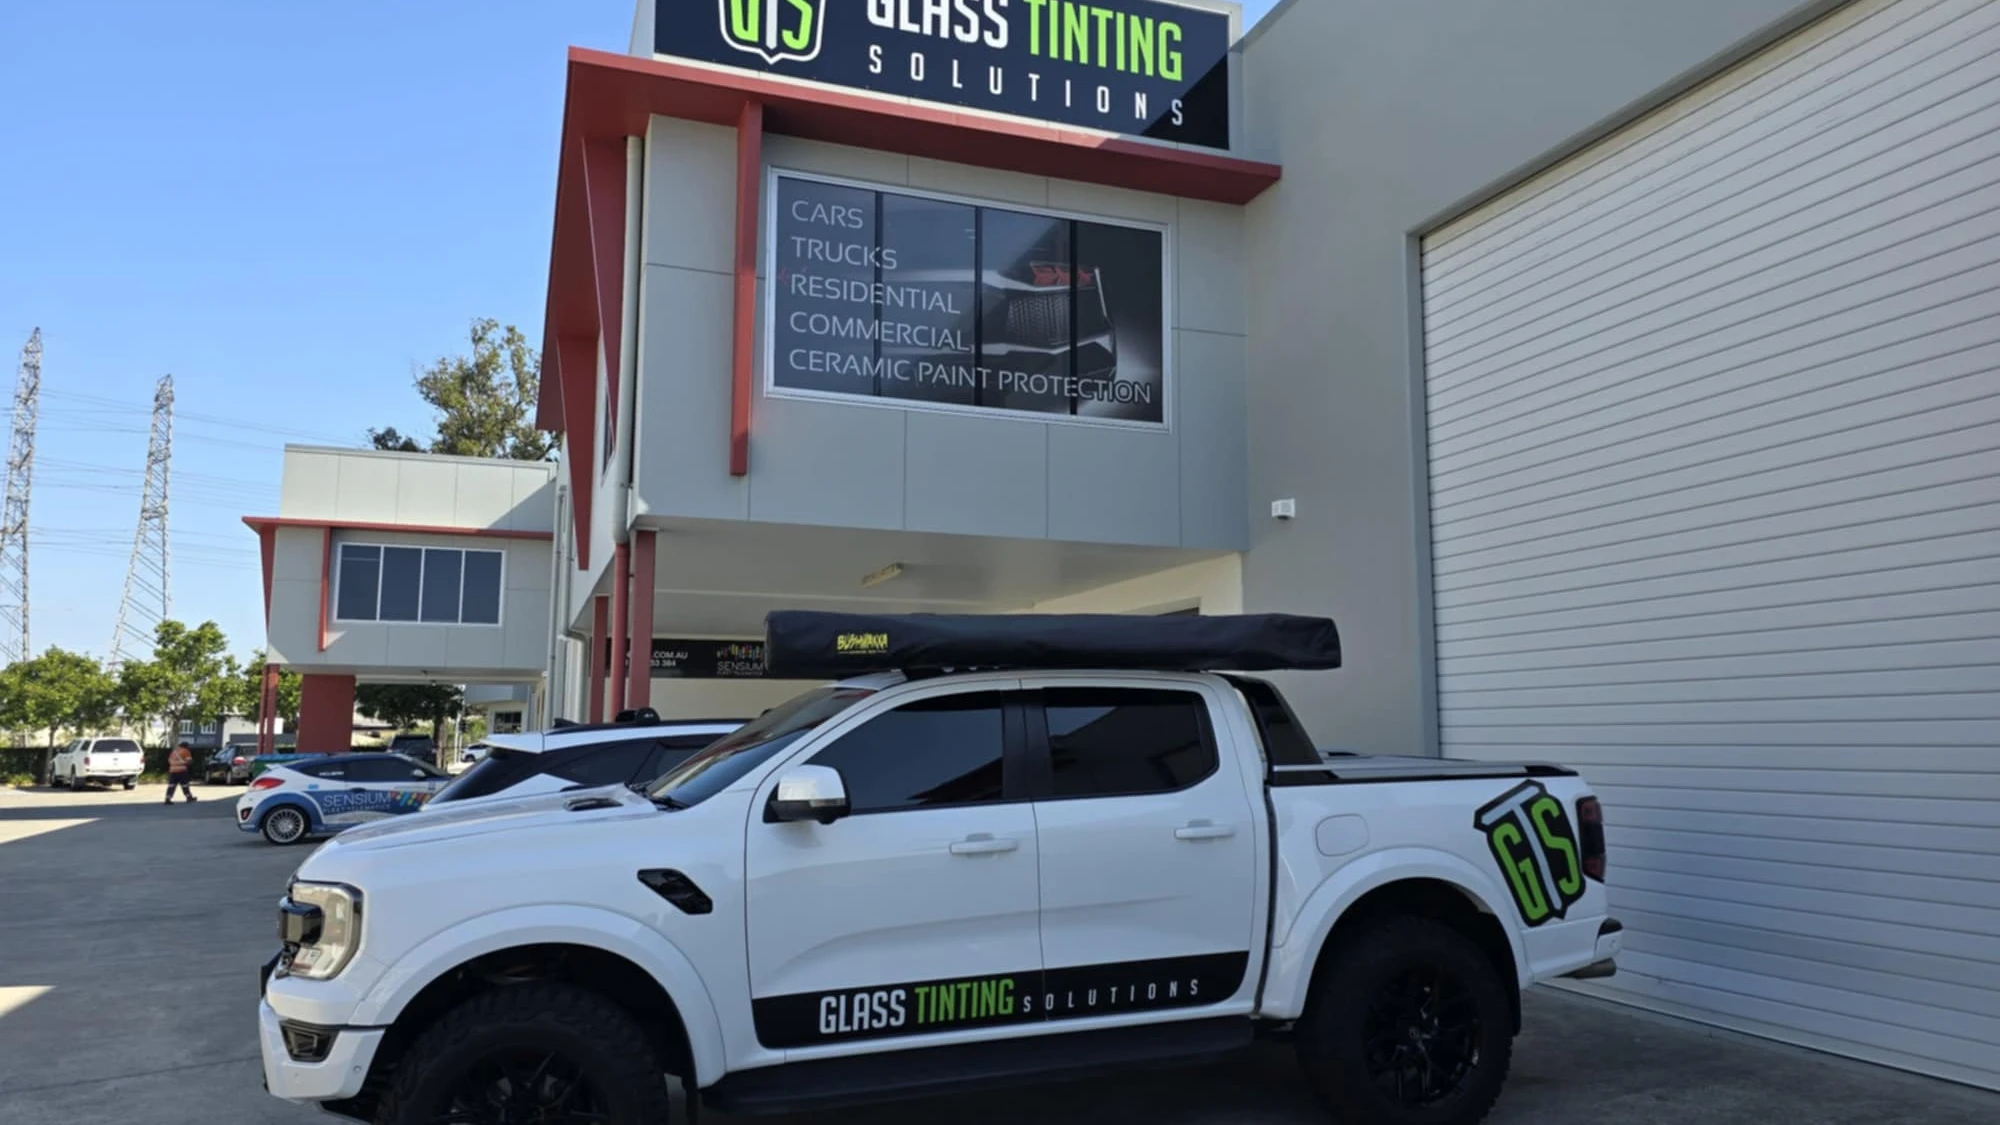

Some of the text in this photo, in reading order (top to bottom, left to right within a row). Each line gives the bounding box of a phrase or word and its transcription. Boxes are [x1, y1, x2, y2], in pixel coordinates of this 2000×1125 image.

[1022, 0, 1183, 82] TINTING
[869, 44, 1183, 126] SOLUTIONS
[791, 200, 864, 229] CARS
[791, 236, 898, 270] TRUCKS
[791, 273, 961, 315] RESIDENTIAL
[790, 311, 971, 352] COMMERCIAL
[790, 349, 1151, 404] CERAMIC PAINT PROTECTION
[323, 791, 392, 808] SENSIUM
[1481, 785, 1581, 920] GTS
[819, 978, 1199, 1034] GLASS TINTING SOLUTIONS
